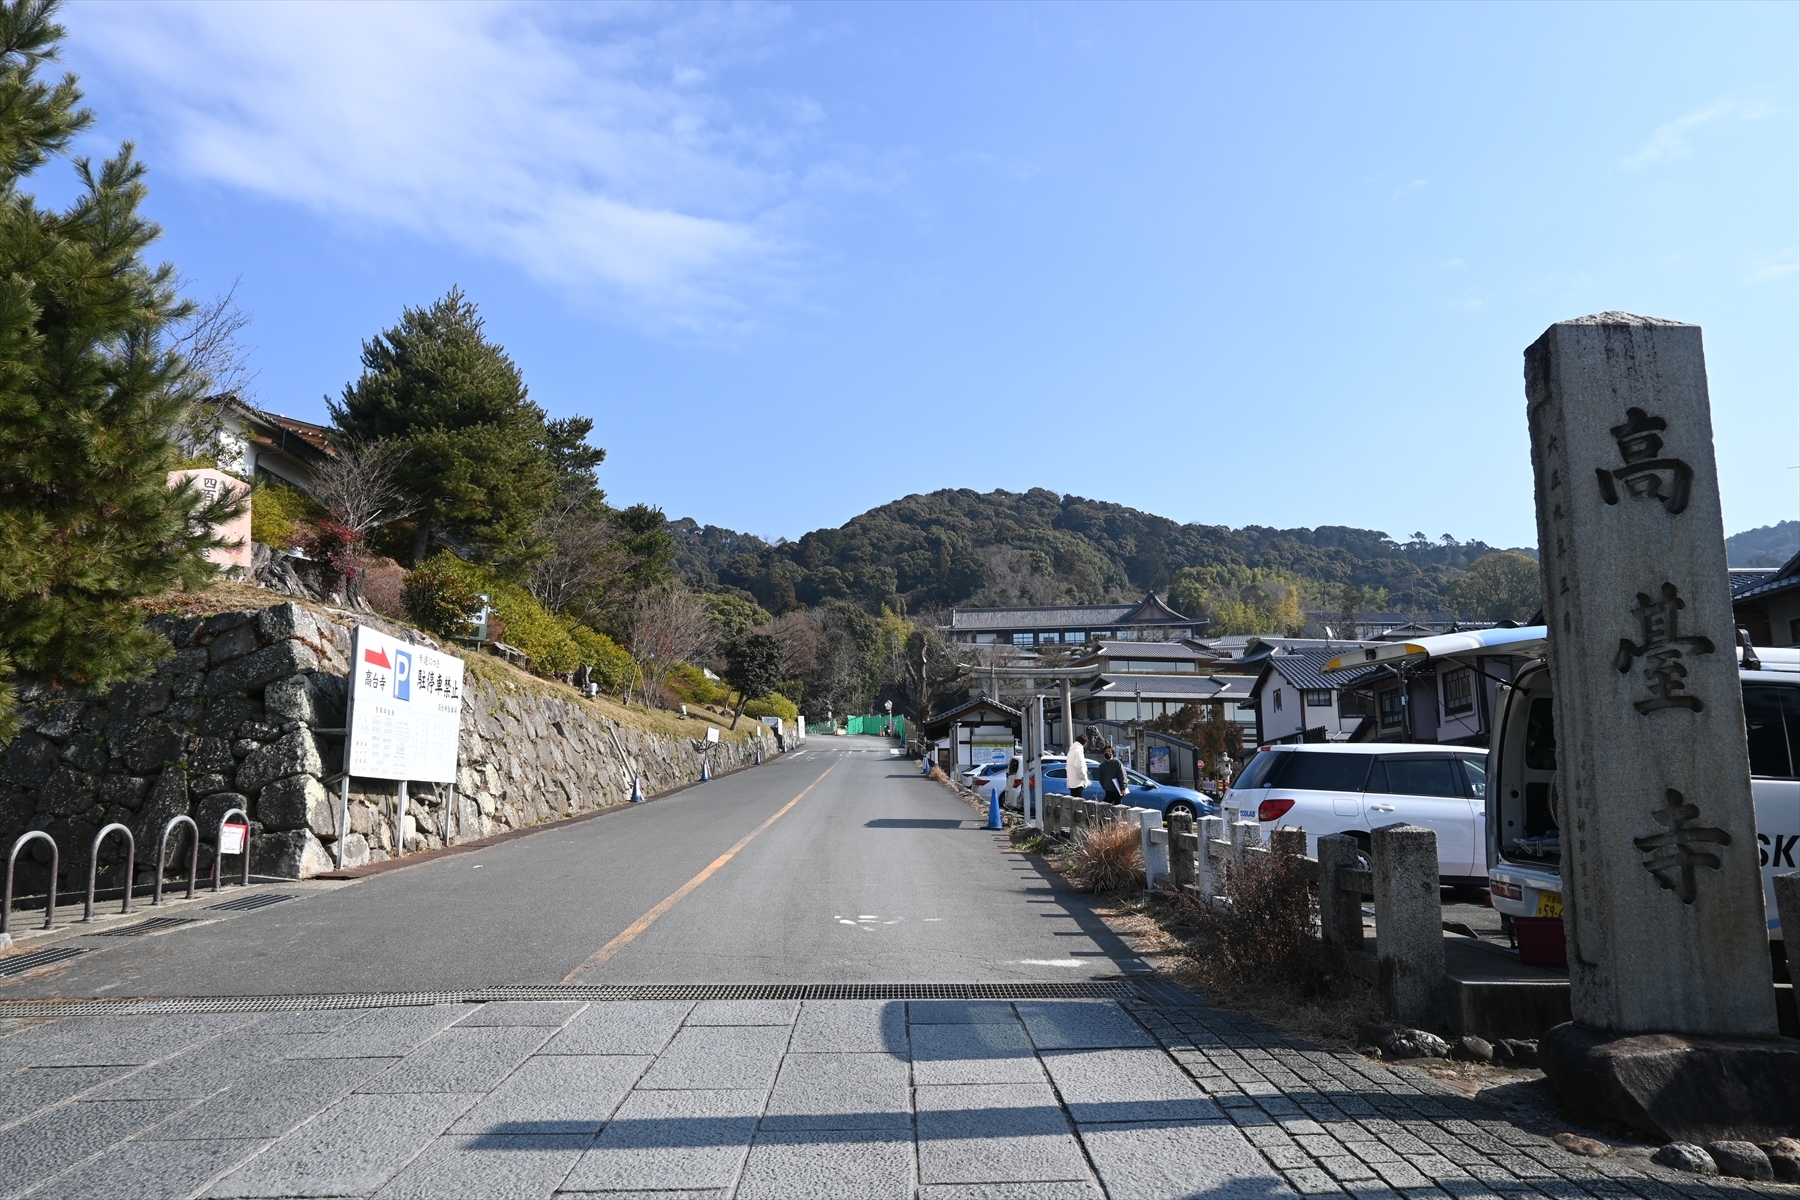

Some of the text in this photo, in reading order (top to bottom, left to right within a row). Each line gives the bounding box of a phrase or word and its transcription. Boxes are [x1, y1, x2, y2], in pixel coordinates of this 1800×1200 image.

[365, 669, 386, 691] 高台寺
[394, 653, 410, 697] P
[417, 670, 459, 699] 駐停車禁止
